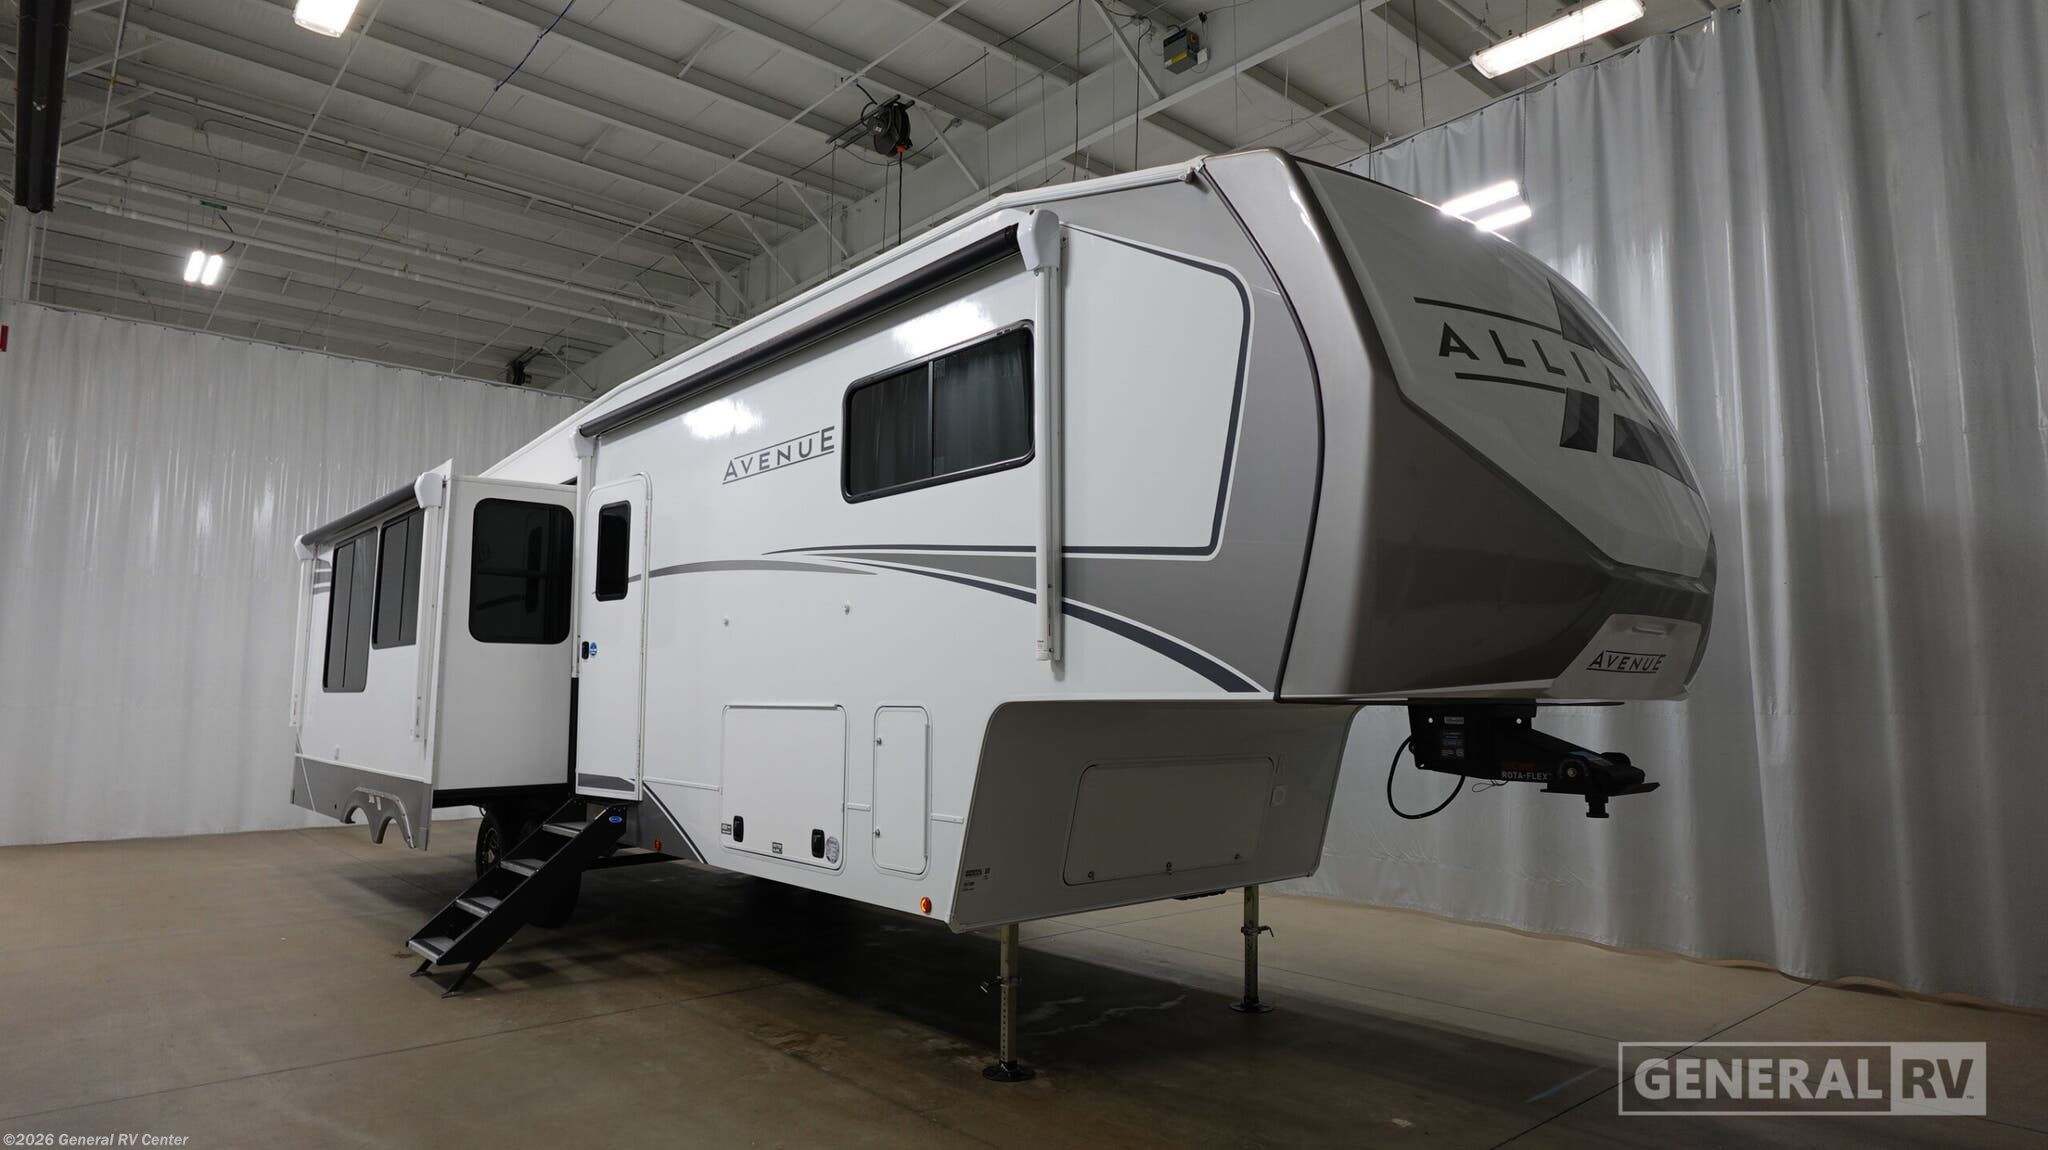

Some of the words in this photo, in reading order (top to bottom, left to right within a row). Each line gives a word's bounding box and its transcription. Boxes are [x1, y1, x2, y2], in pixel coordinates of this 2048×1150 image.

[722, 426, 836, 483] AVENUE
[1588, 650, 1667, 673] AVENUE
[1501, 770, 1549, 782] ROTA-FLEX
